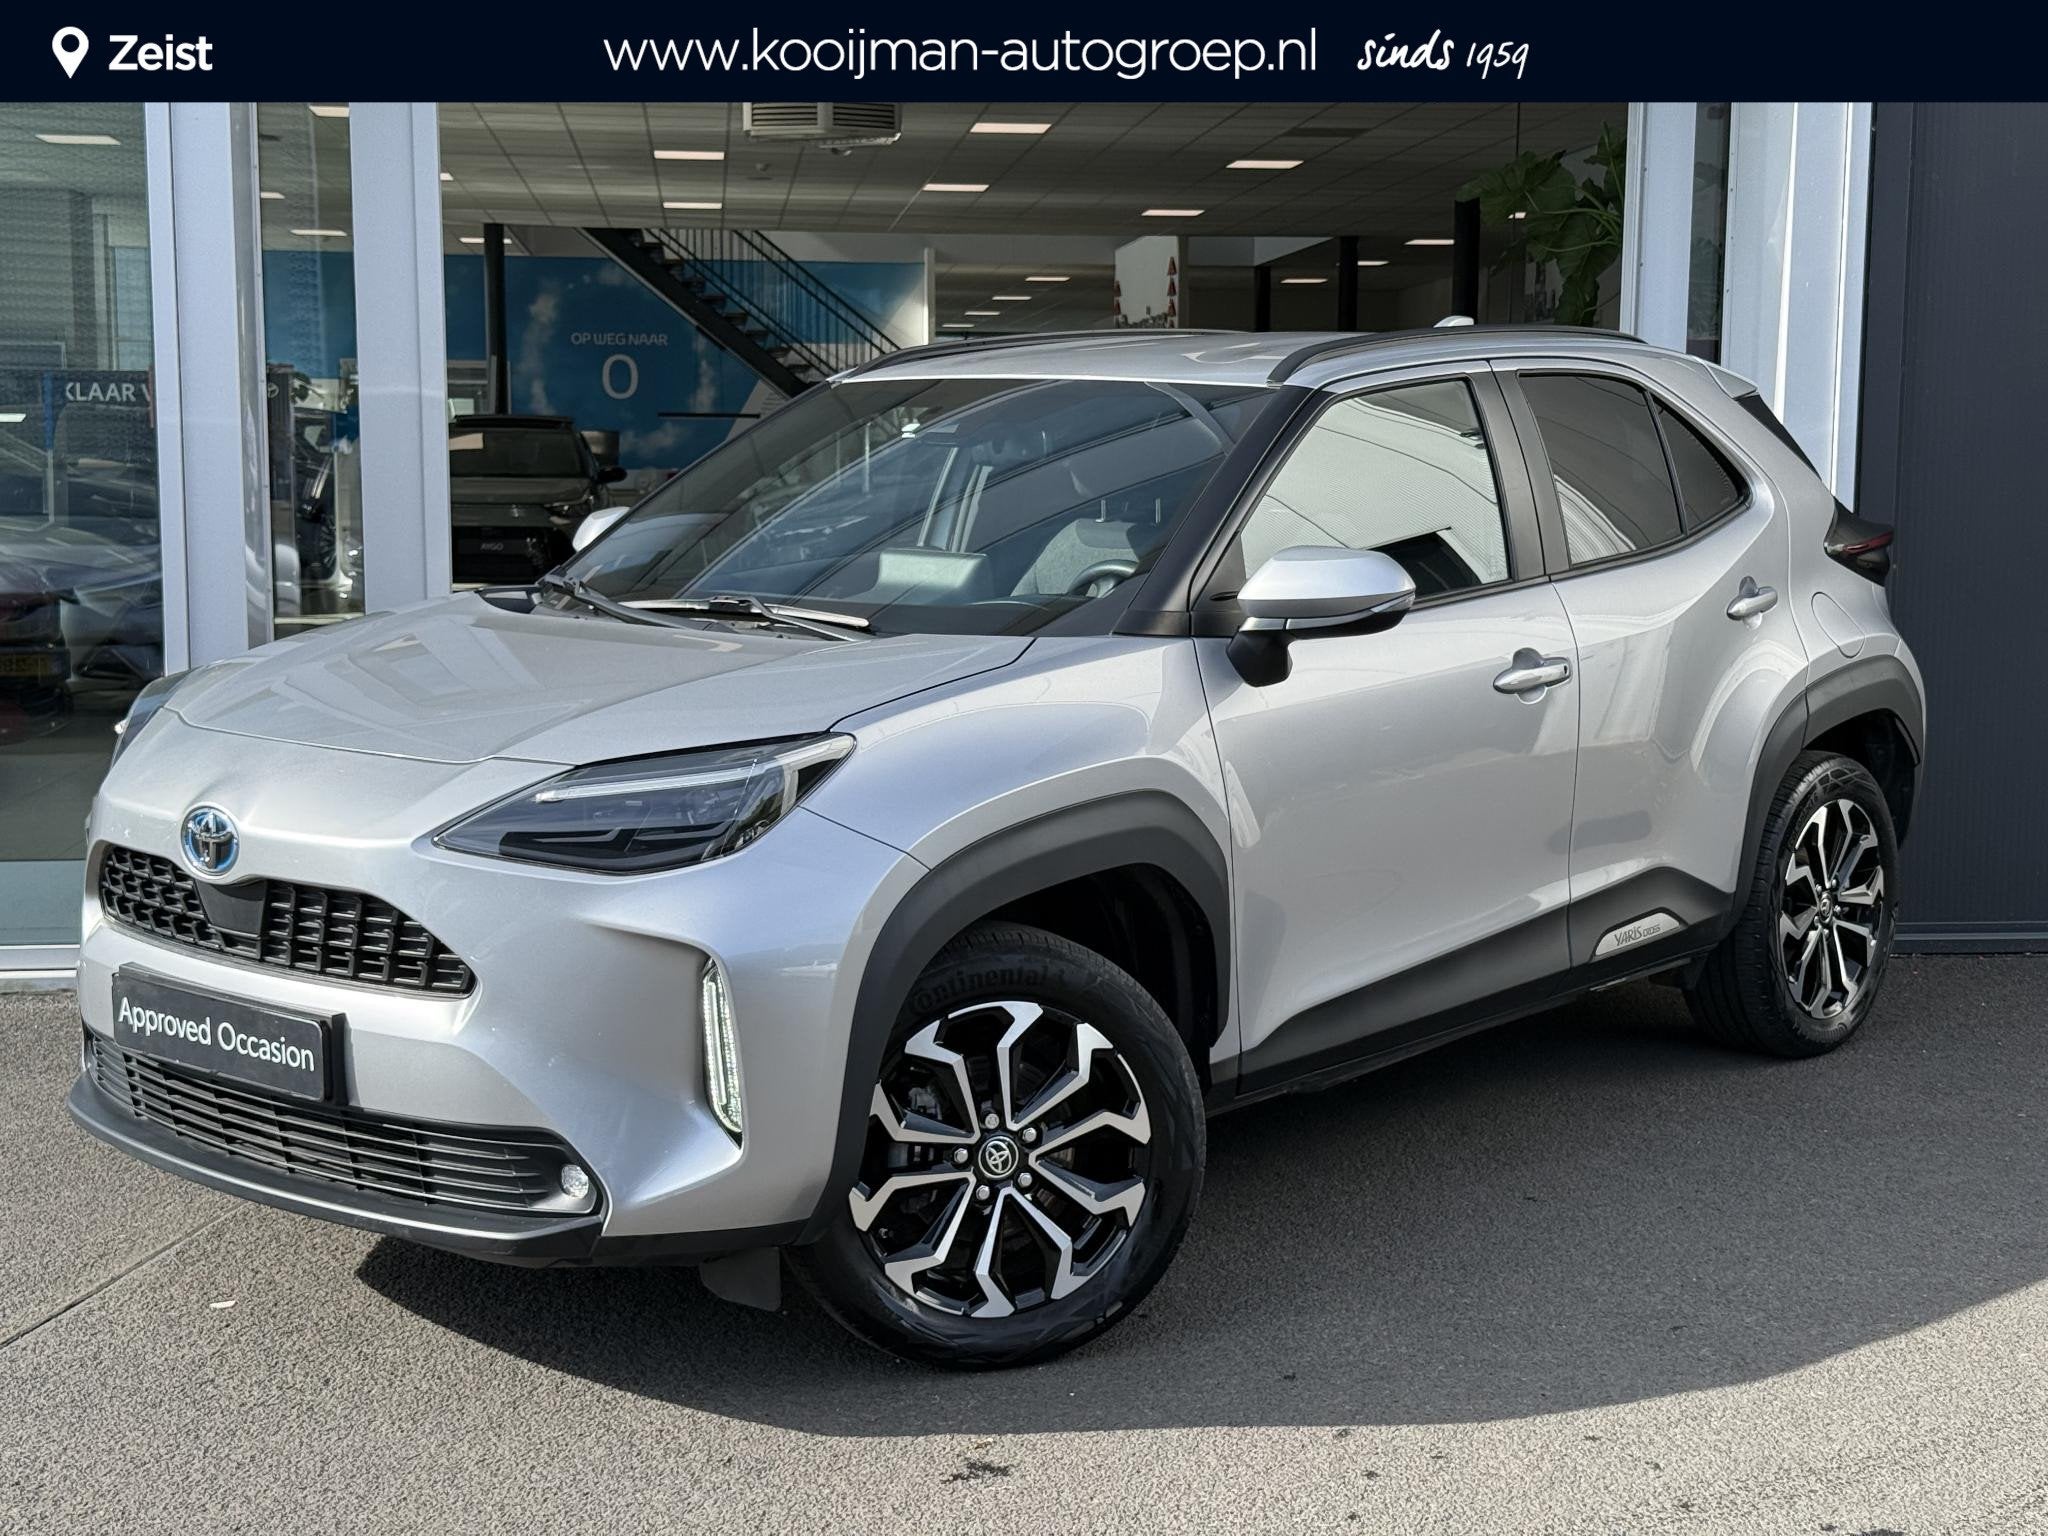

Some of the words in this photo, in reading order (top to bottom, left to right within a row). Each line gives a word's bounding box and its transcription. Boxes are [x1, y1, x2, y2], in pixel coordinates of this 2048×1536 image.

[571, 332, 592, 345] OP
[594, 333, 626, 346] WEG
[628, 334, 668, 347] NAAR
[1614, 925, 1642, 946] YARIS
[117, 996, 212, 1046] Approved
[217, 1021, 315, 1072] Occasion
